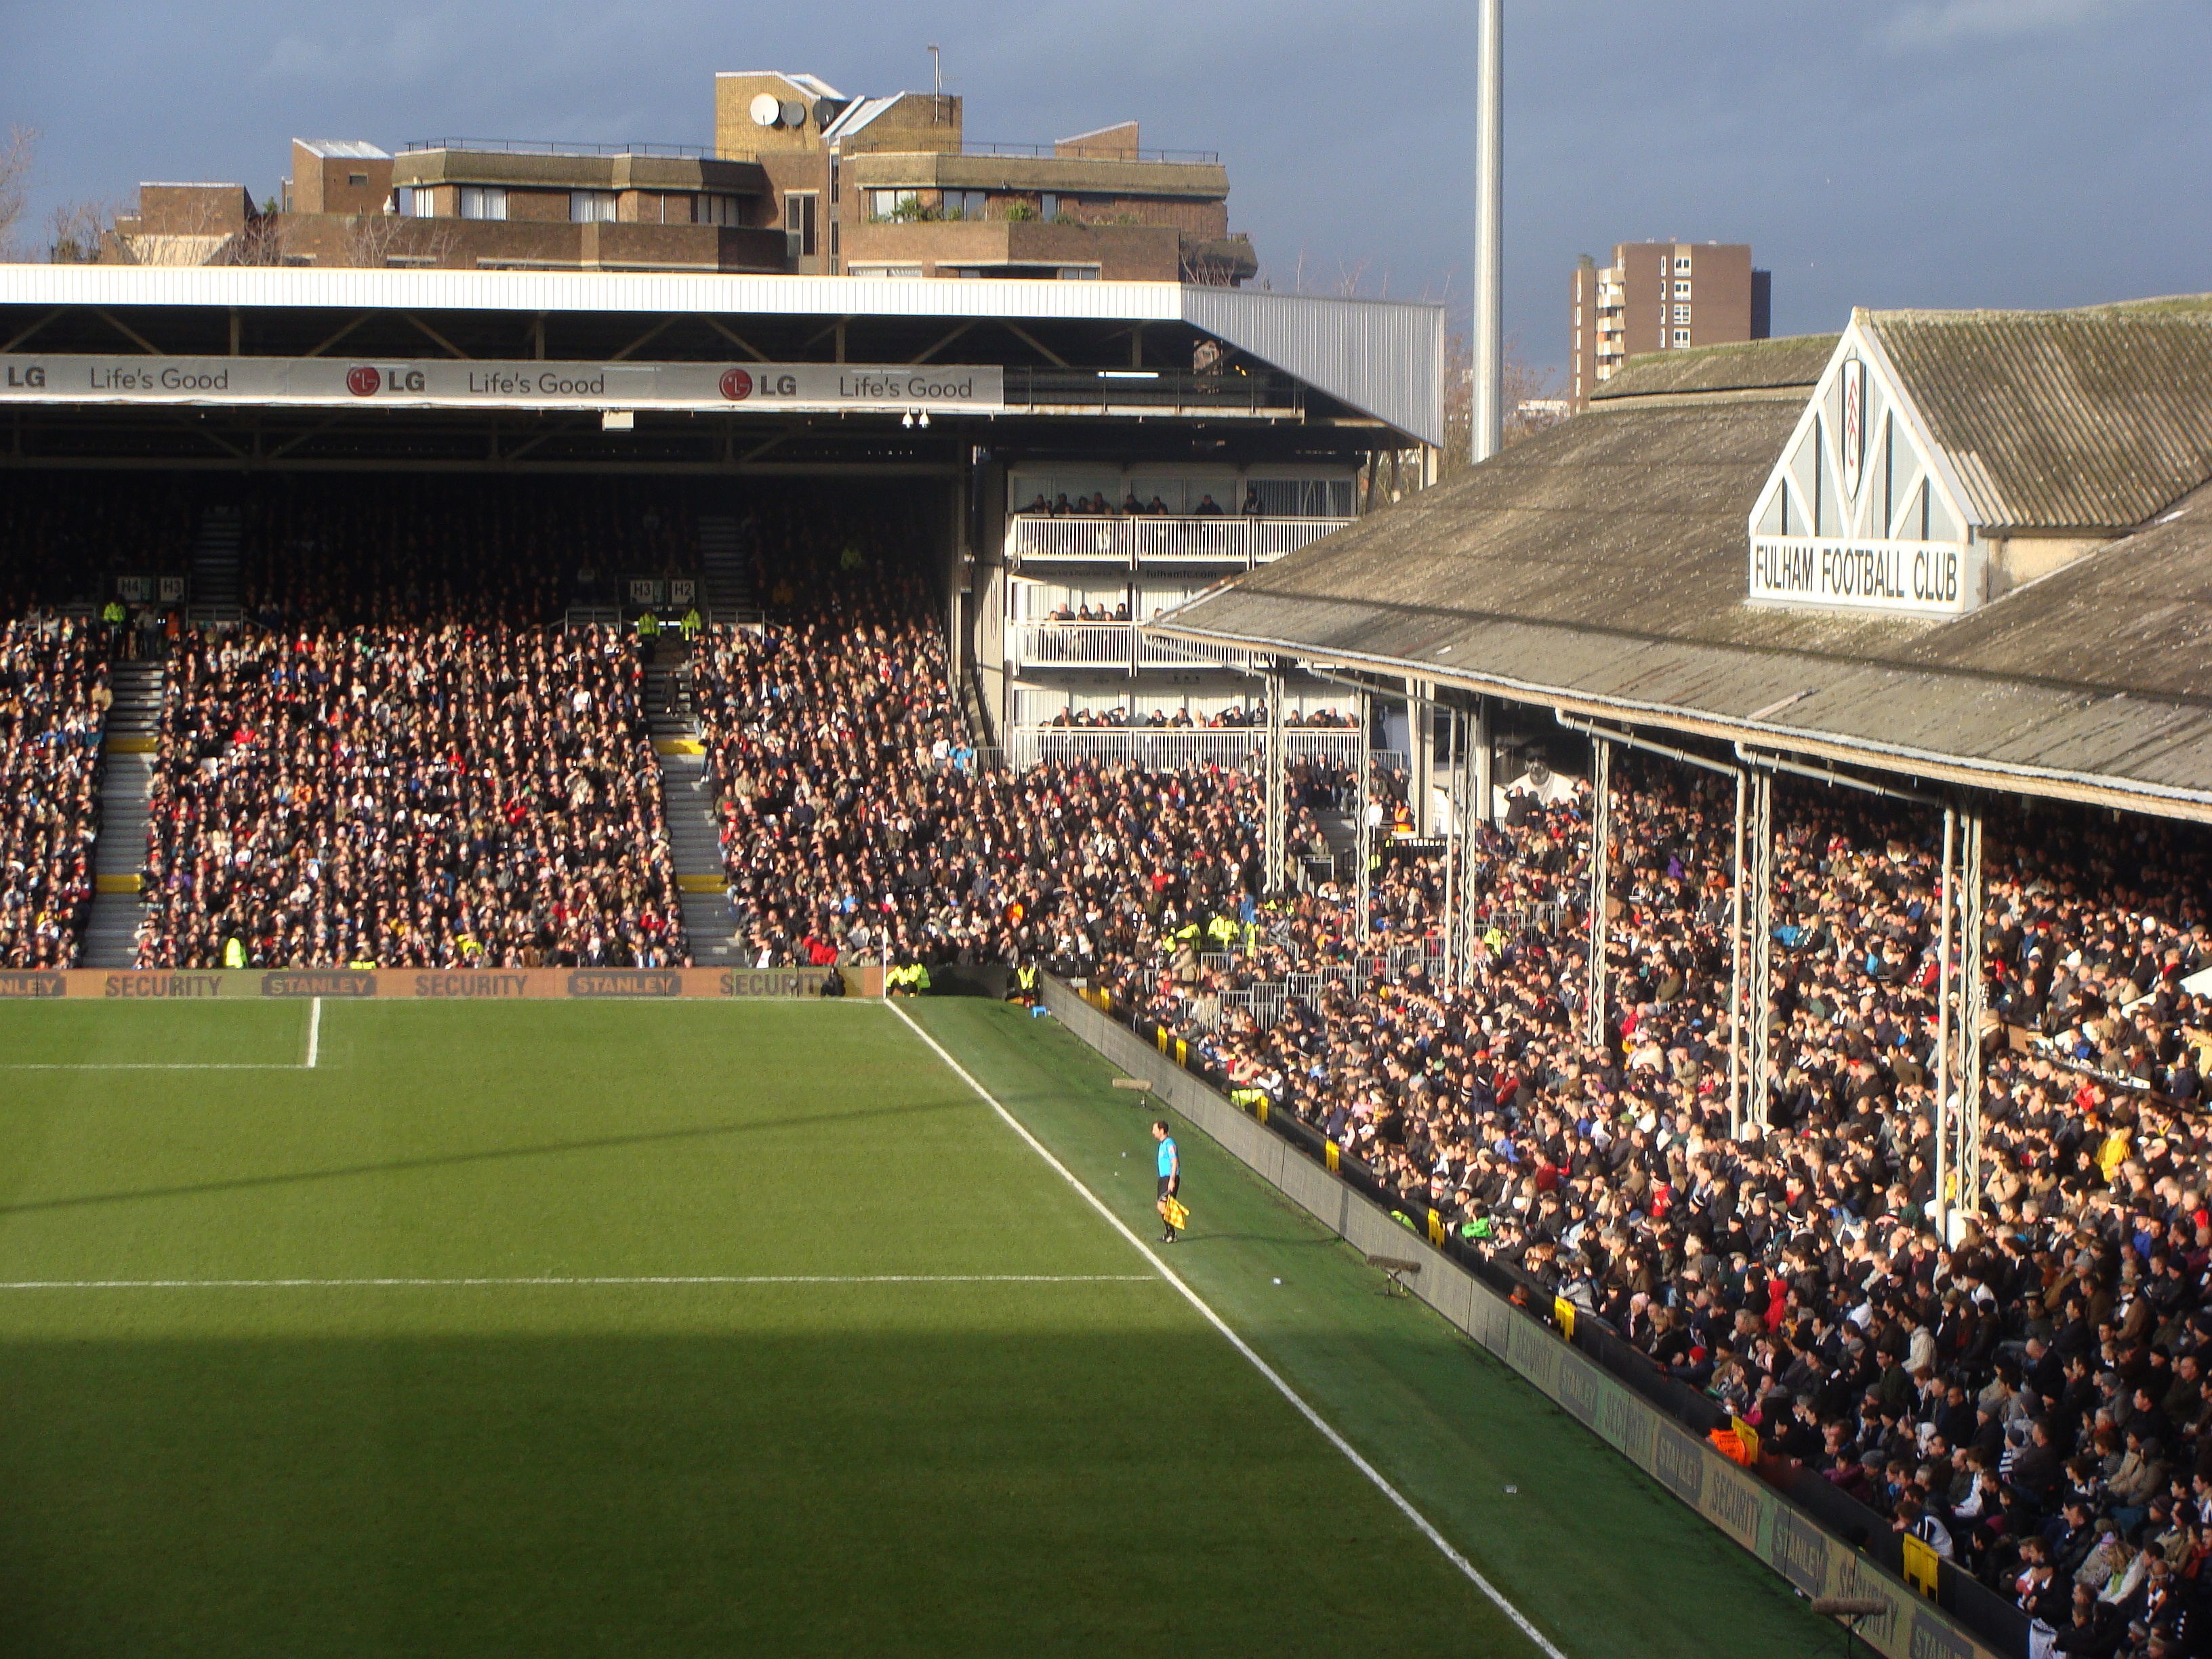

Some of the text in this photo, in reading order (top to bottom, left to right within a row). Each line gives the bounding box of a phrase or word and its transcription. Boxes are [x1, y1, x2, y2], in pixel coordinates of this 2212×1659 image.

[8, 367, 228, 390] LG Life's Good
[388, 371, 605, 394] LG Life's Good
[760, 375, 972, 398] LG Life's Good
[1756, 545, 1957, 602] FULHAM FOOTBALL CLUB
[675, 582, 691, 596] H2
[0, 975, 222, 997] NLEY SECURITY
[272, 975, 529, 997] STANLEY SECURITY
[577, 977, 673, 994] STANLEY
